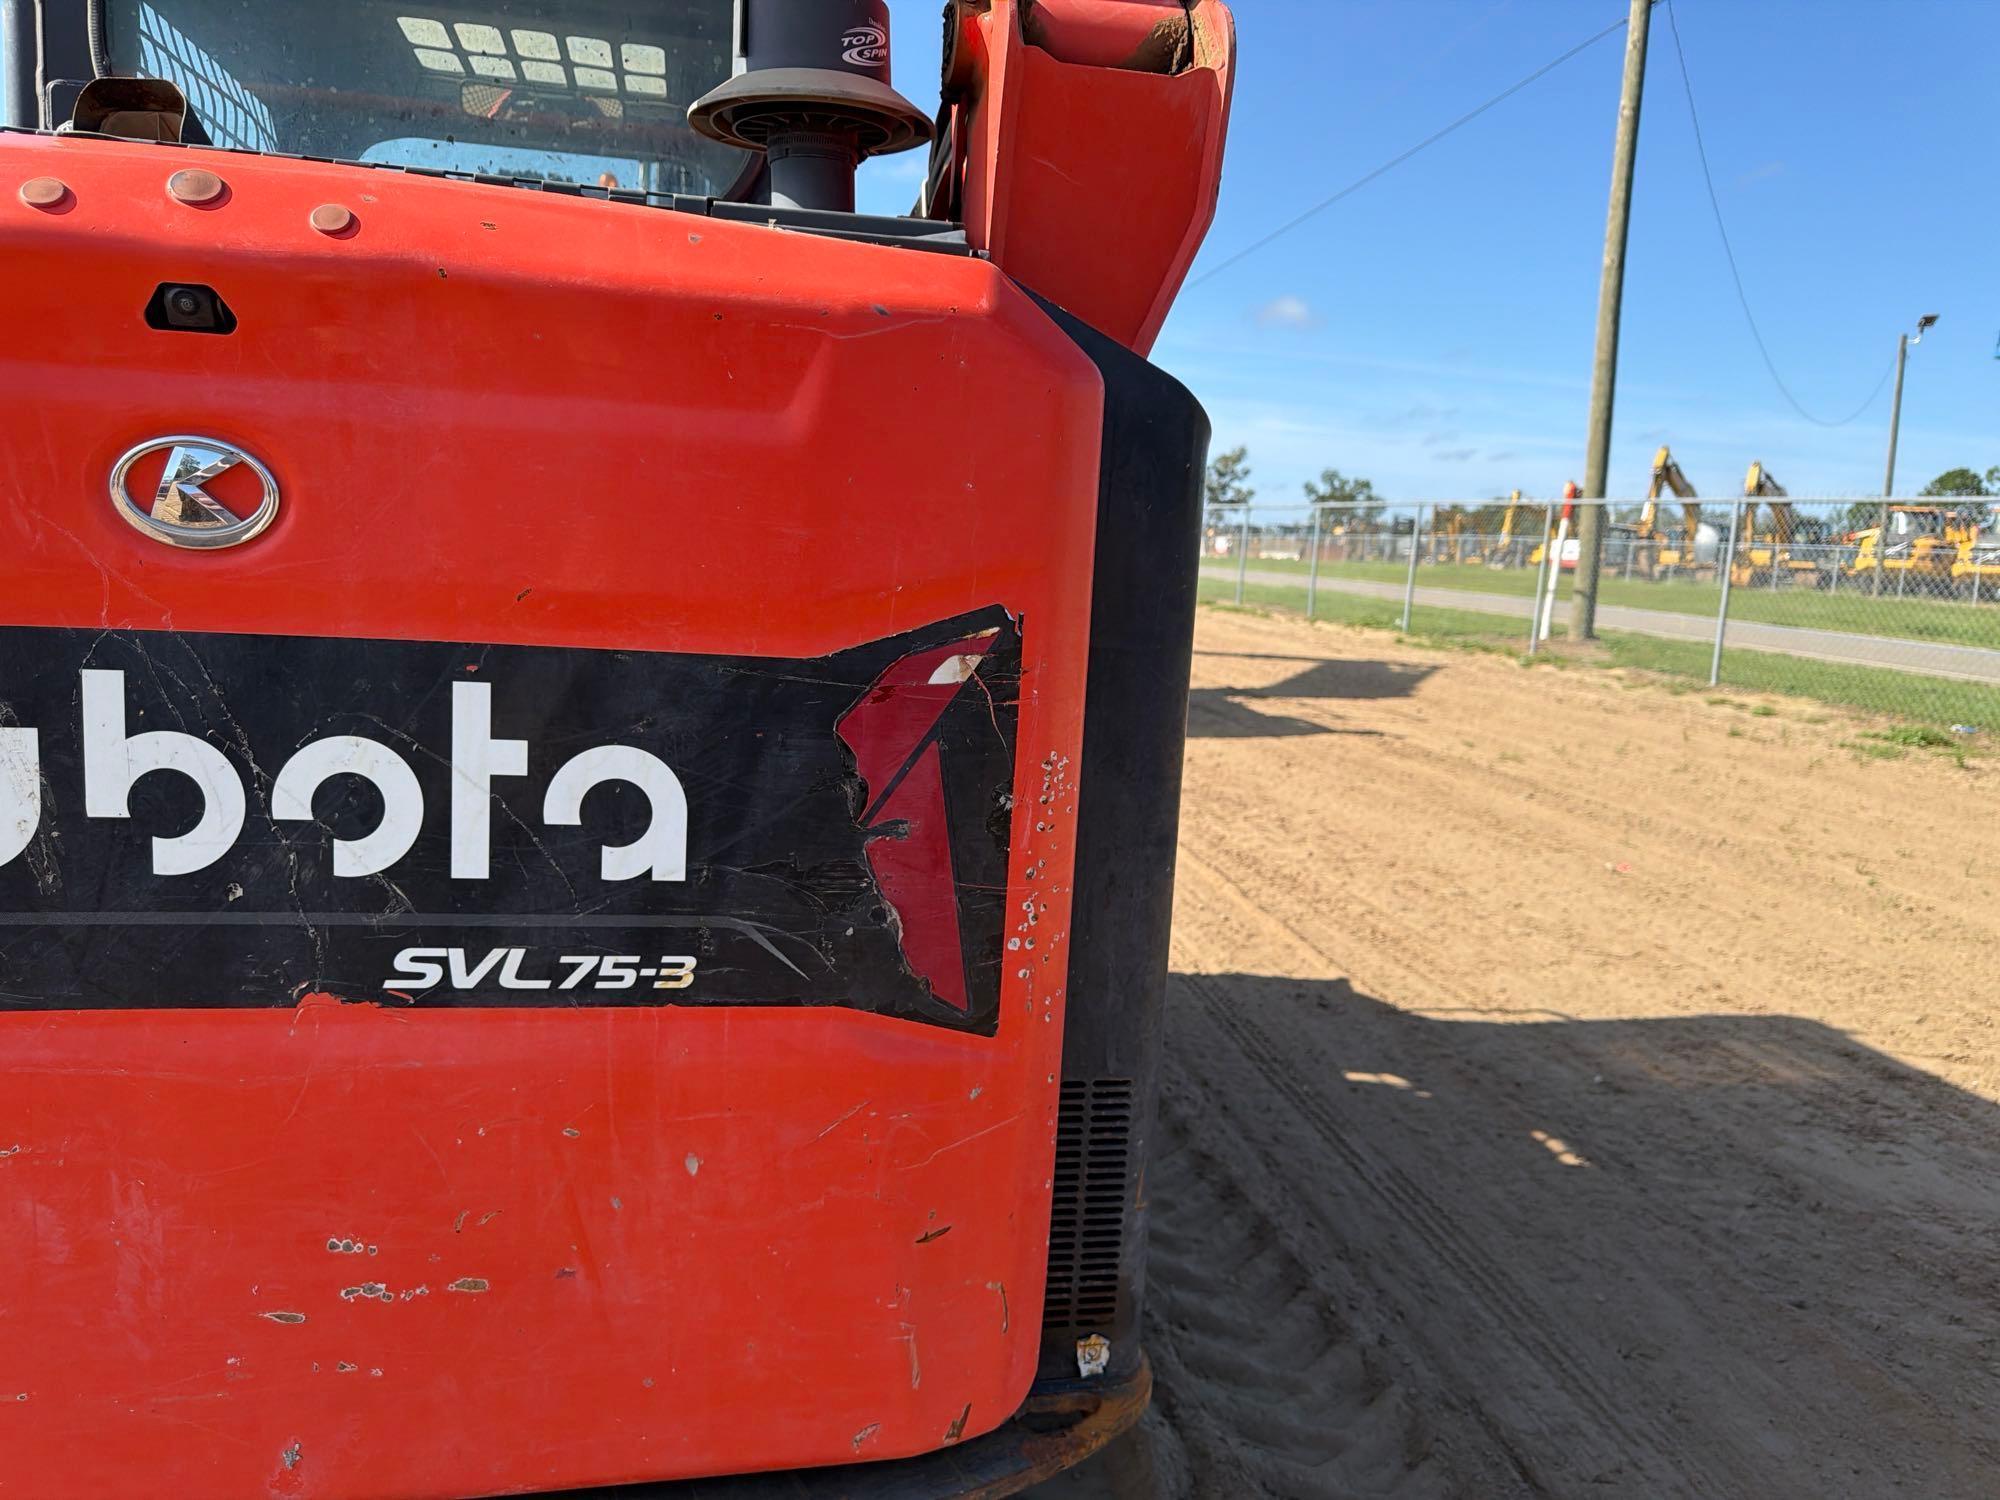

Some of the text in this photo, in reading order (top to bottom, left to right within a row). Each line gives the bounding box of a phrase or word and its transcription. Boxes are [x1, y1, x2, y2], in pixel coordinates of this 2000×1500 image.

[841, 34, 875, 47] TOP
[862, 48, 888, 59] SPIN
[0, 668, 688, 882] bota
[382, 947, 697, 989] SVL 75-3
